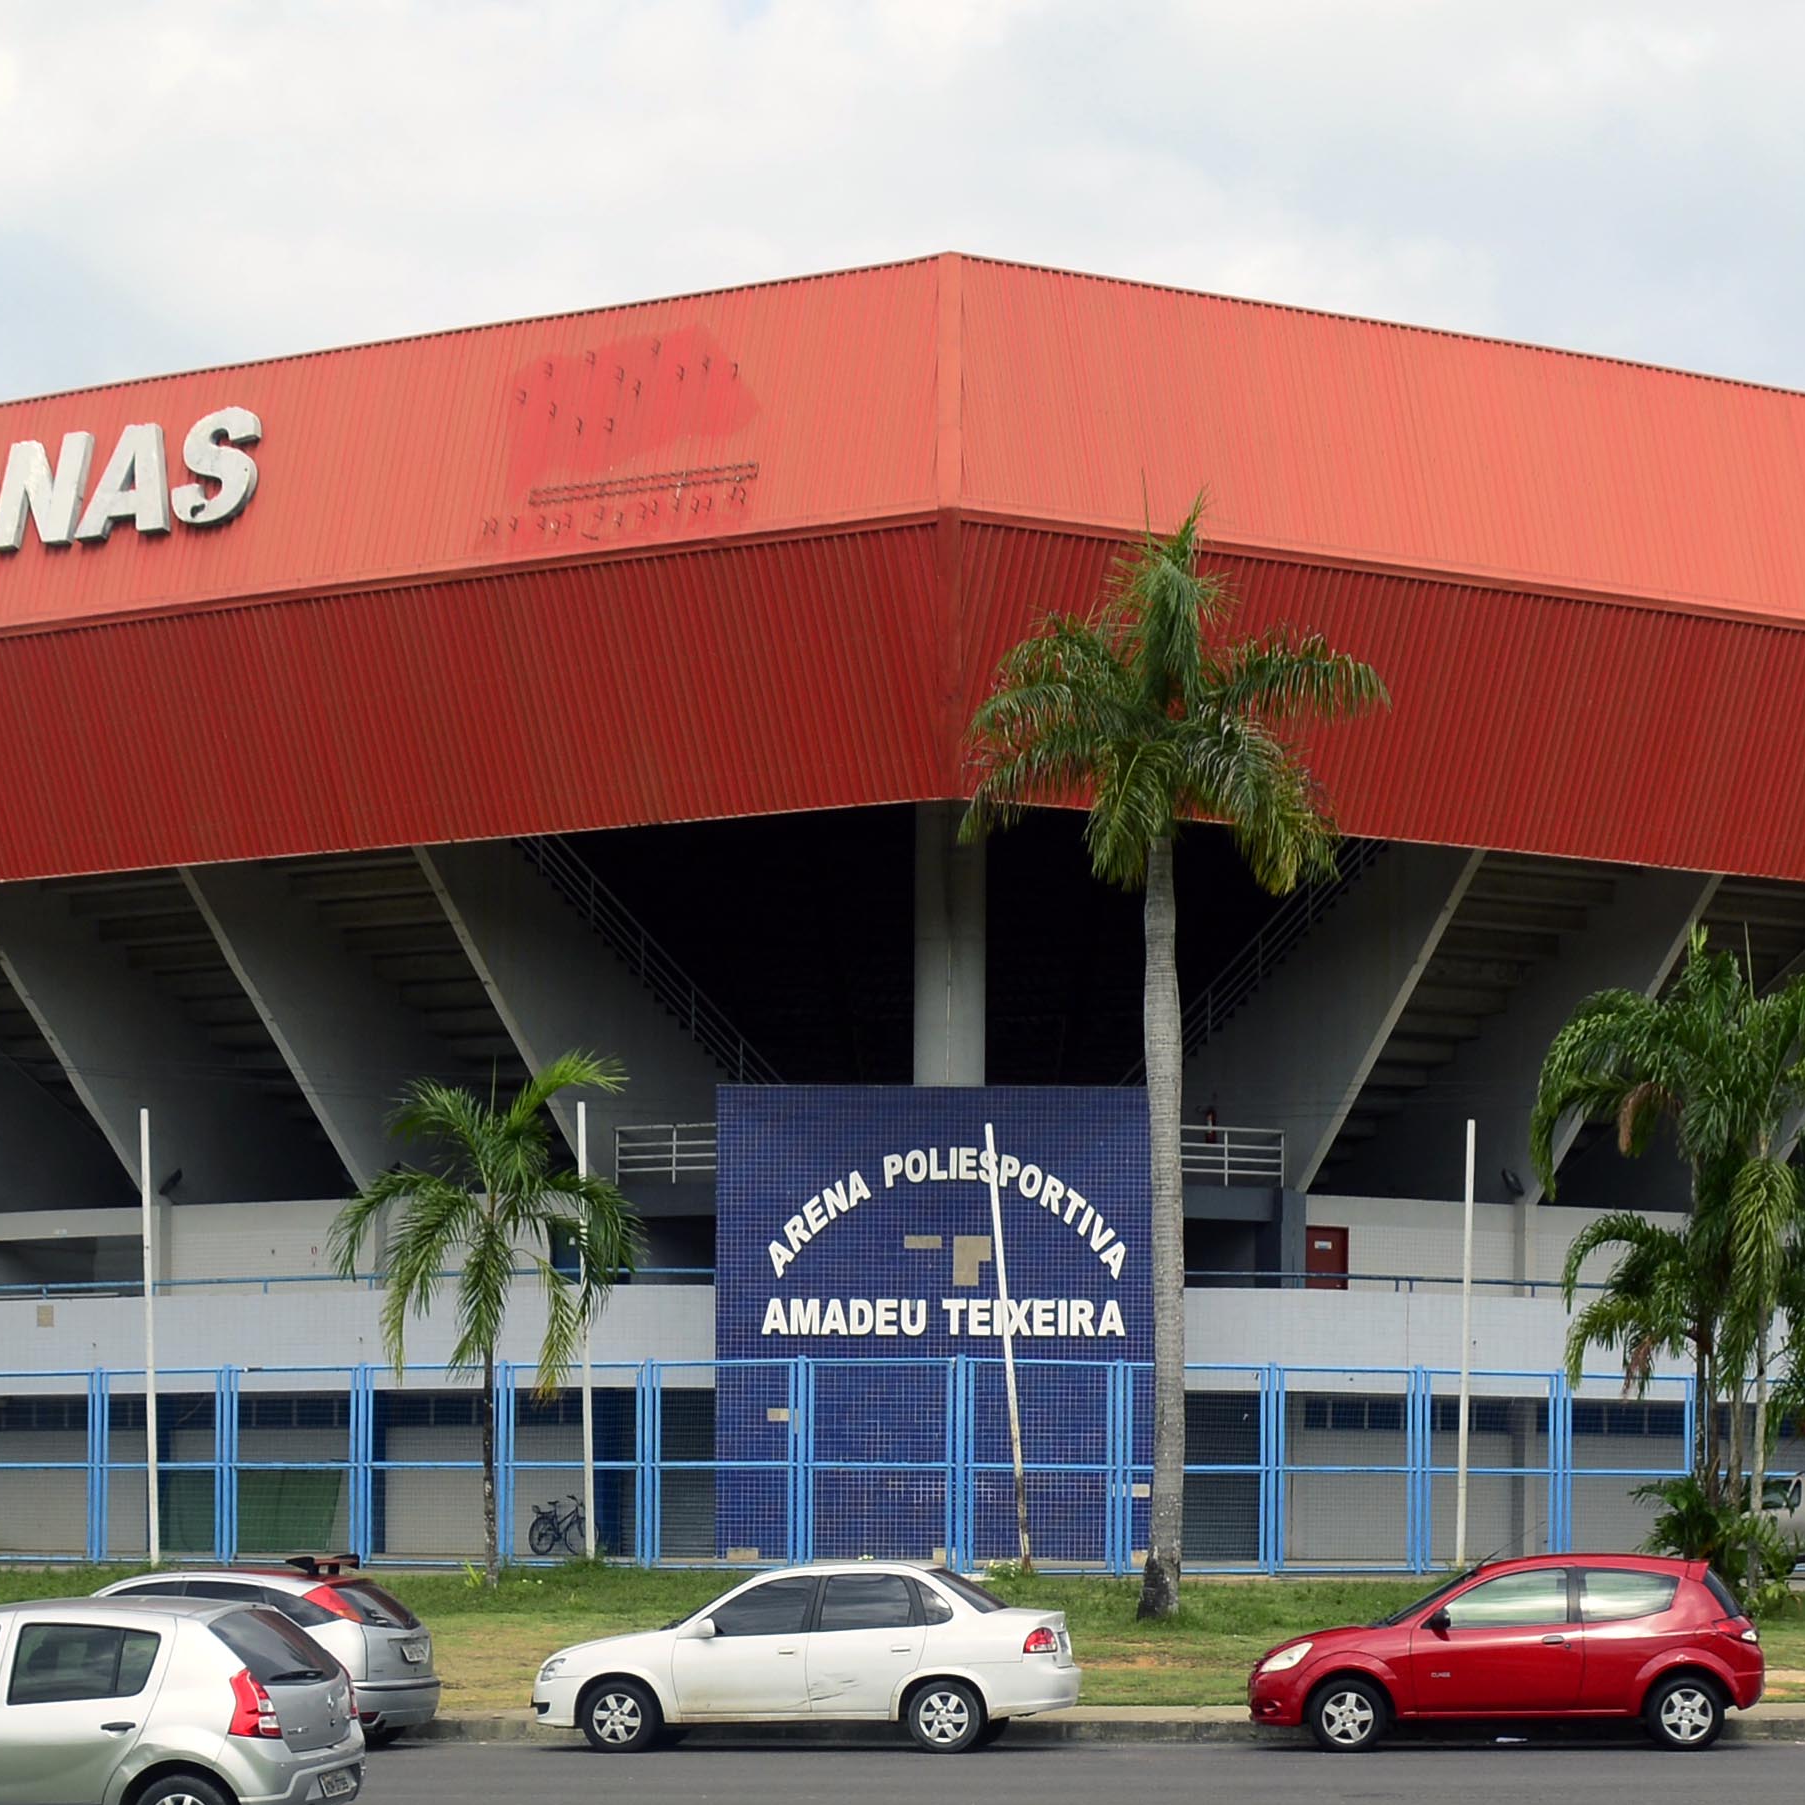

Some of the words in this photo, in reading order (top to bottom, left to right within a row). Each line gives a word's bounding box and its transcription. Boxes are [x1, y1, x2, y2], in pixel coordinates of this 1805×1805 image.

[767, 1169, 872, 1279] ARENA
[882, 1147, 1127, 1281] POLIESPORTIVA
[761, 1298, 927, 1337] AMADEU
[941, 1298, 1126, 1337] TEIXEIRA
